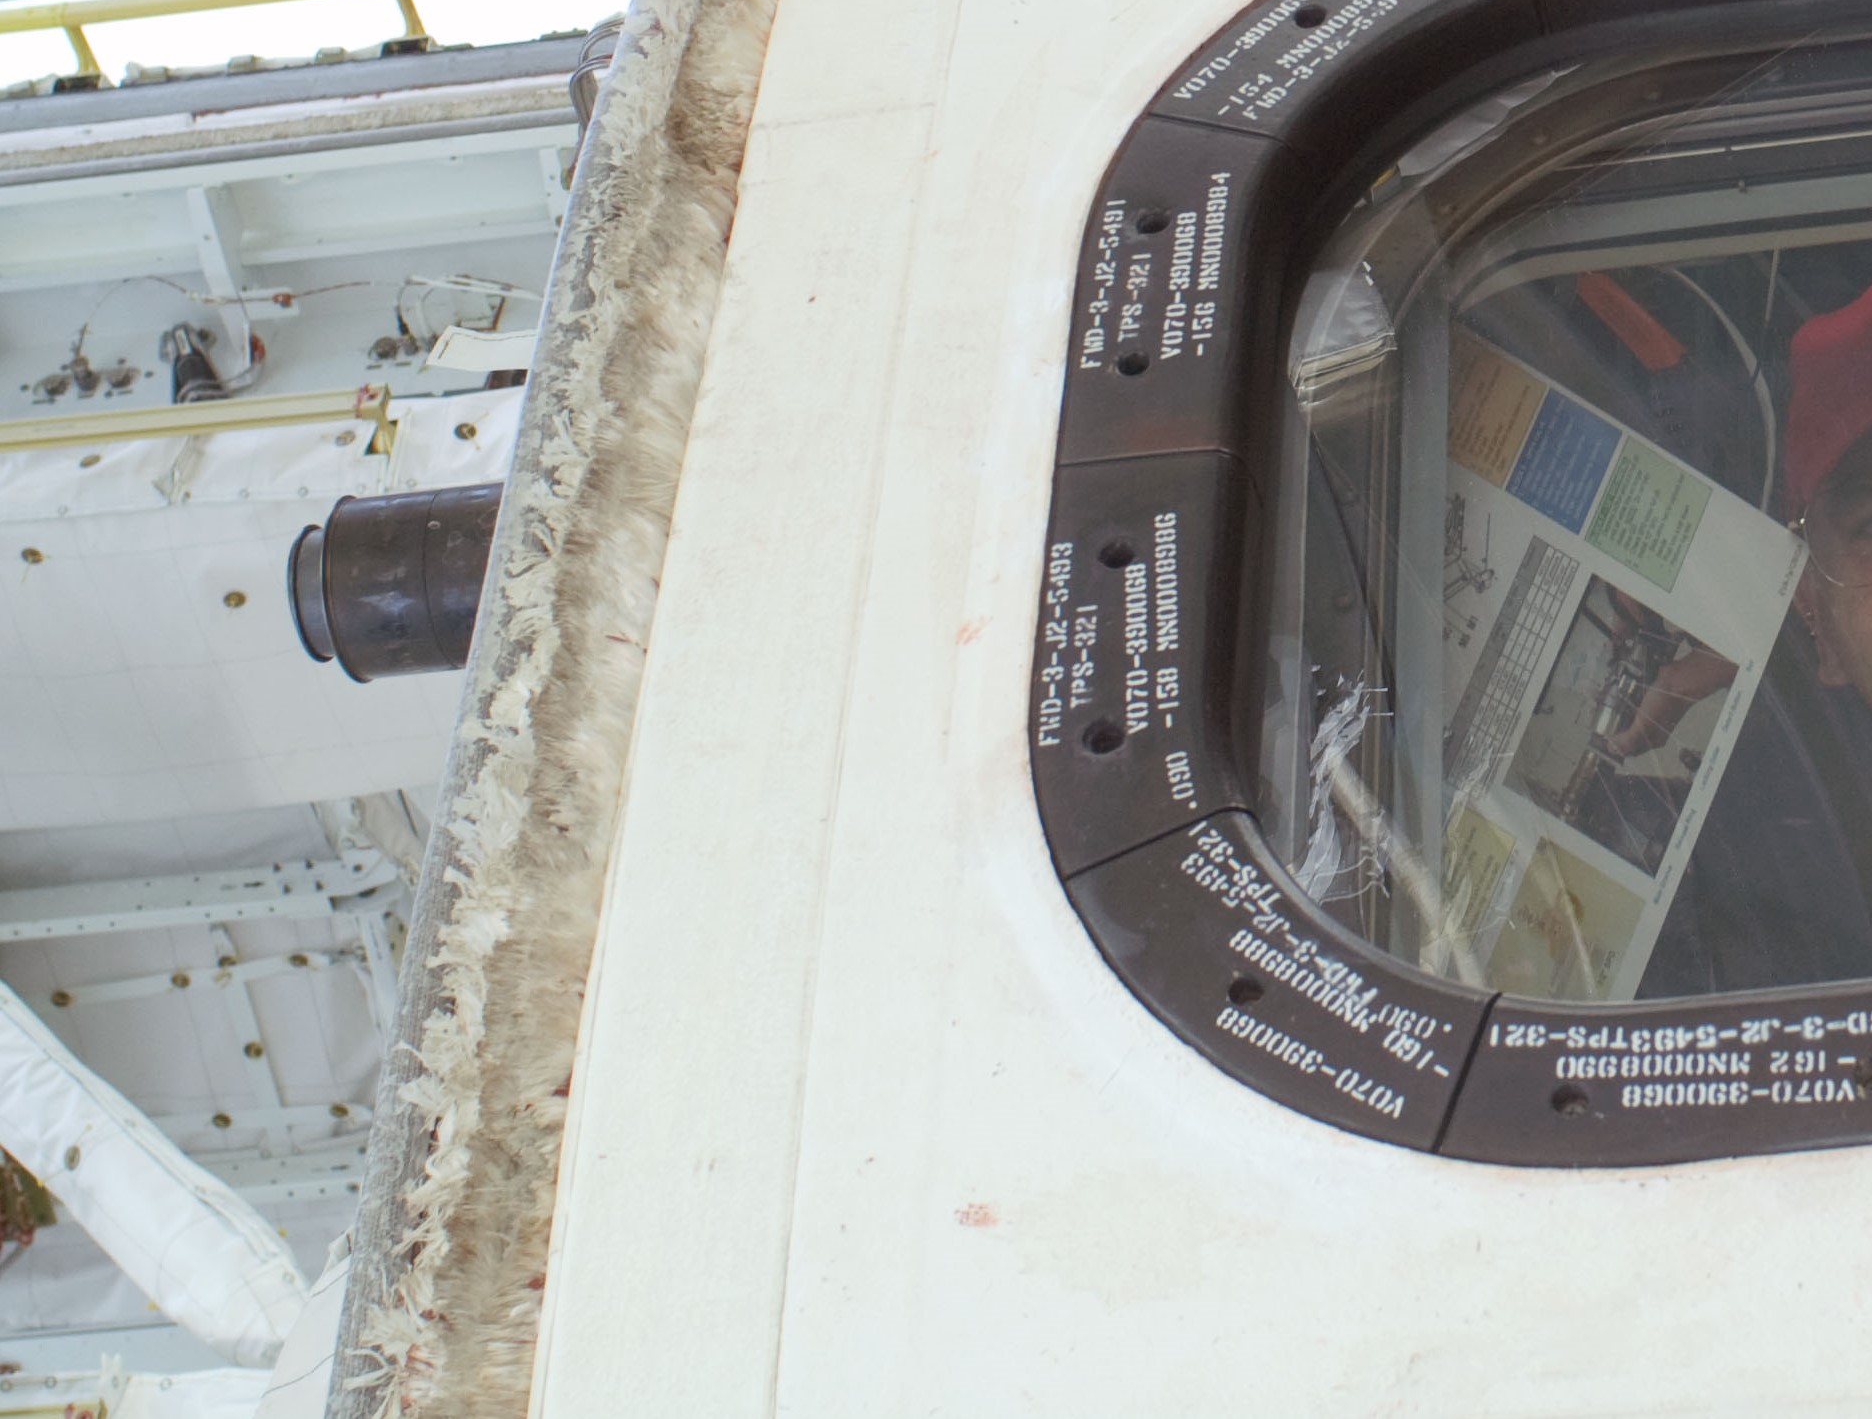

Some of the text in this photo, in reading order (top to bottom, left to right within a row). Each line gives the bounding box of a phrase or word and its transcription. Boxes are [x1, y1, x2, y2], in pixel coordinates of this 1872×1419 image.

[1217, 72, 1274, 116] -154
[1078, 198, 1127, 370] FWD-3-J2-5491
[1117, 252, 1153, 343] TPS-321
[1159, 211, 1198, 360] V070-390068
[1190, 171, 1232, 357] -156 MN0008984
[1037, 541, 1074, 747] FWD-3-J2-5493
[1069, 603, 1100, 709] TPS-321
[1123, 563, 1150, 735] V070-390068
[1154, 511, 1180, 729] -158 MN0008986
[1164, 750, 1199, 811] .090
[1188, 820, 1281, 915] TPS-321
[1180, 853, 1379, 1012] FWD-3-J2-5493
[1229, 928, 1379, 1034] MN0008988
[1215, 1006, 1406, 1119] V070-390068
[1378, 1003, 1453, 1039] .090
[1555, 1049, 1858, 1081] -162 MN0008990
[1621, 1082, 1856, 1109] V070-390068
